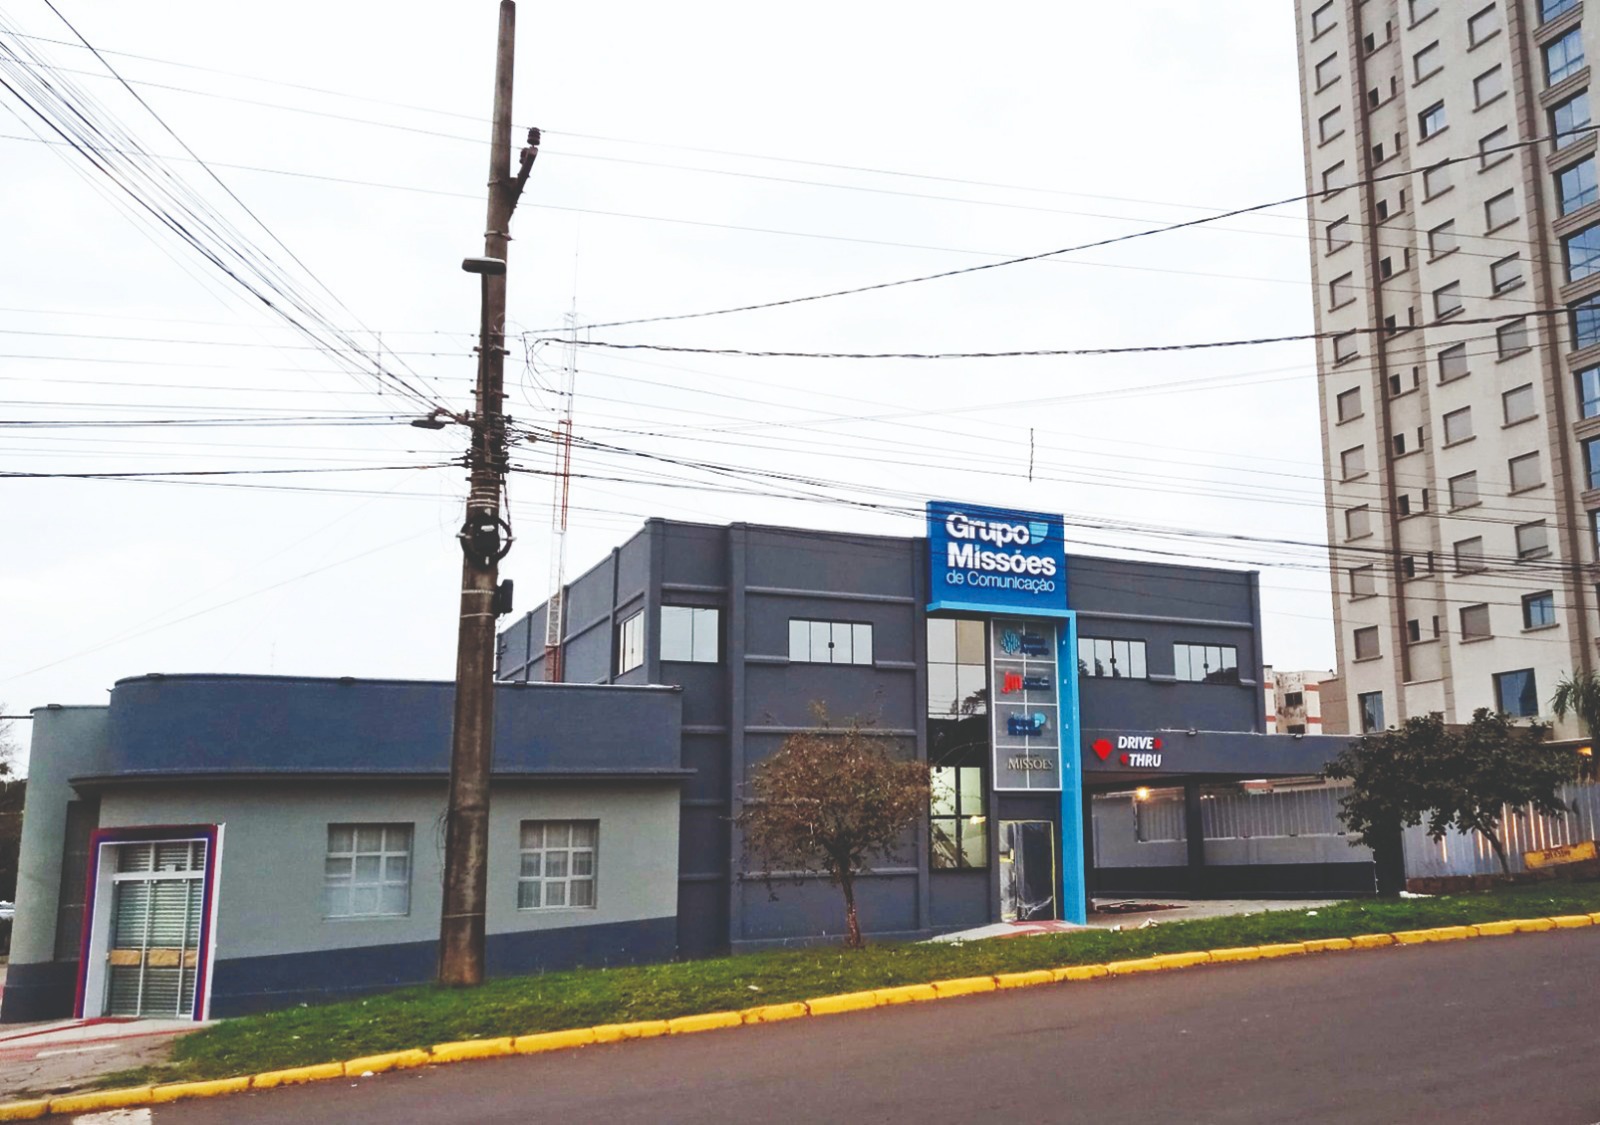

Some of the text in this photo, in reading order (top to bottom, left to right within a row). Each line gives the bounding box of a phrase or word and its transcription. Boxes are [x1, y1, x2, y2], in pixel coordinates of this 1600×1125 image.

[945, 512, 1030, 548] Grupo
[947, 541, 1057, 576] Missões
[946, 570, 1055, 594] de Comunicação
[1117, 736, 1154, 750] DRIVE
[1129, 753, 1162, 767] THRU
